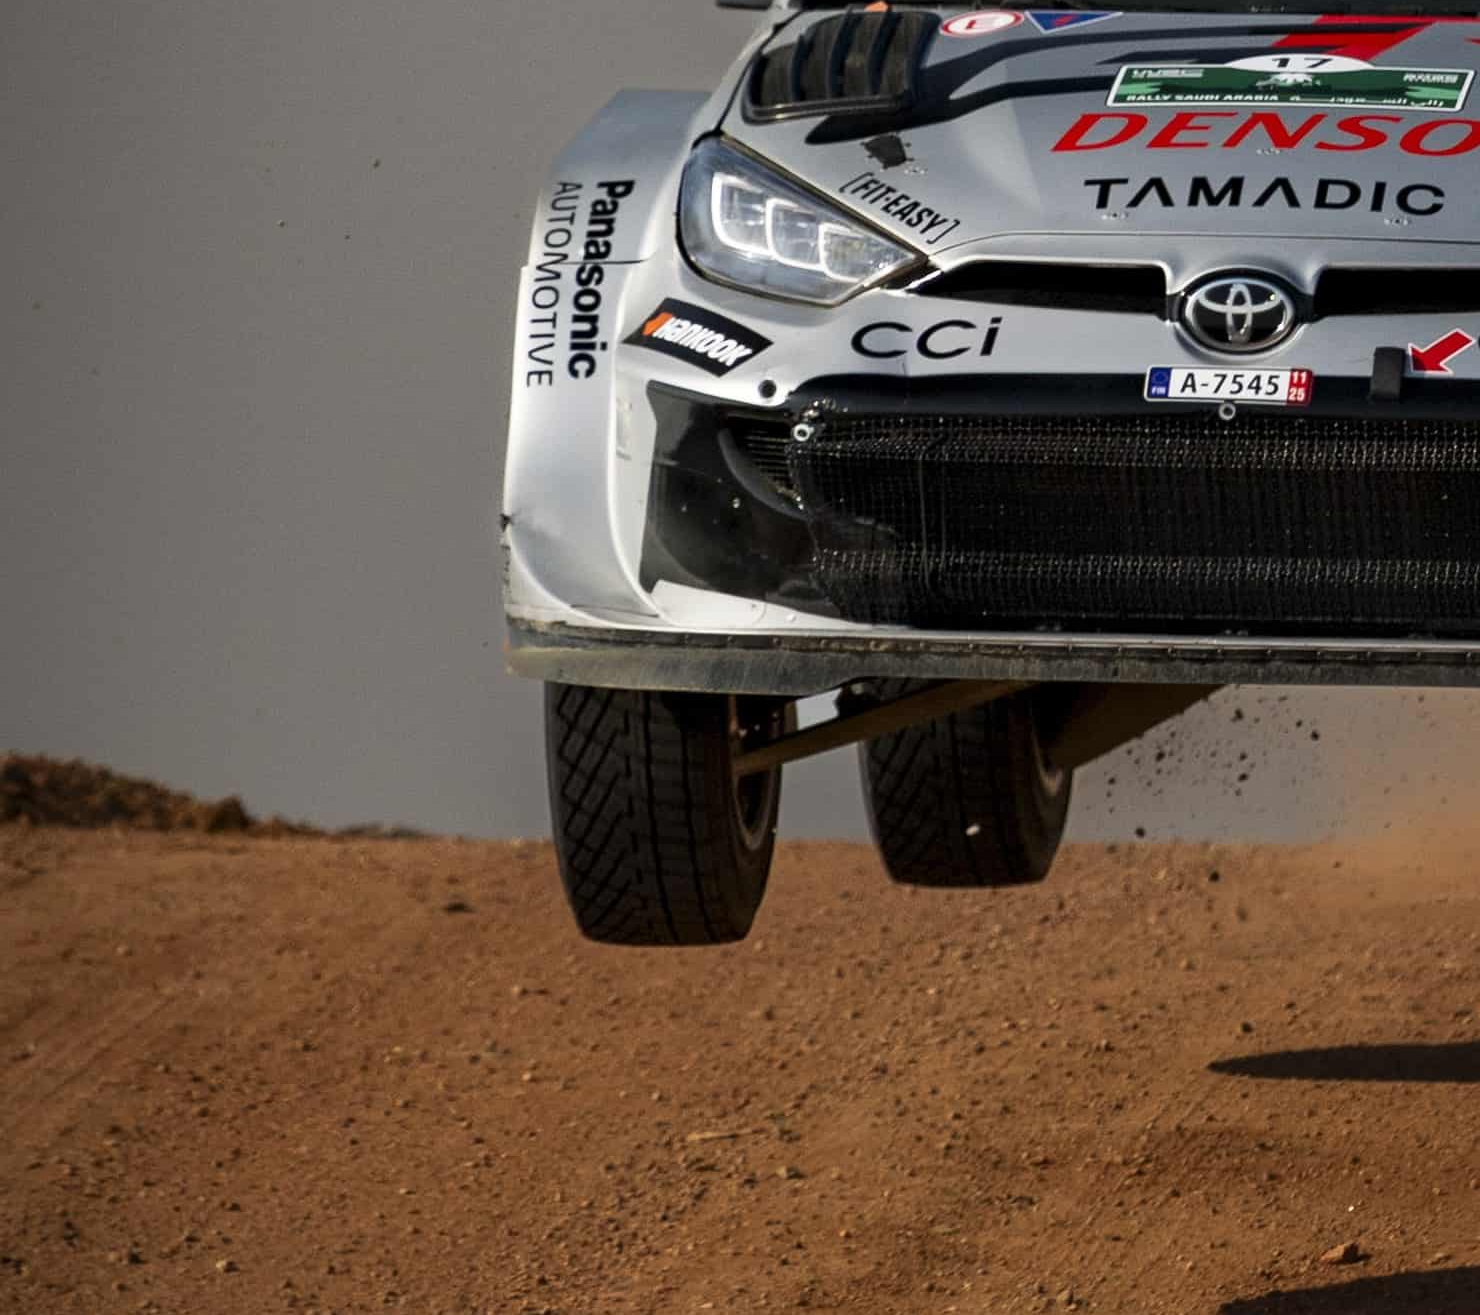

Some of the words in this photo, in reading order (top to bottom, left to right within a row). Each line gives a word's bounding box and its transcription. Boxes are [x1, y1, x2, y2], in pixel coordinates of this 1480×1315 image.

[1271, 57, 1333, 70] 17
[1125, 93, 1171, 102] RALLY
[1173, 93, 1219, 102] SAUDI
[1222, 94, 1280, 102] ARABIA
[1083, 176, 1446, 216] TAMADIC
[526, 181, 583, 388] AUTOMOTIVE
[567, 179, 636, 379] Panasonic
[1180, 372, 1281, 397] A-7545
[1291, 371, 1307, 384] 11
[1288, 387, 1306, 402] 25
